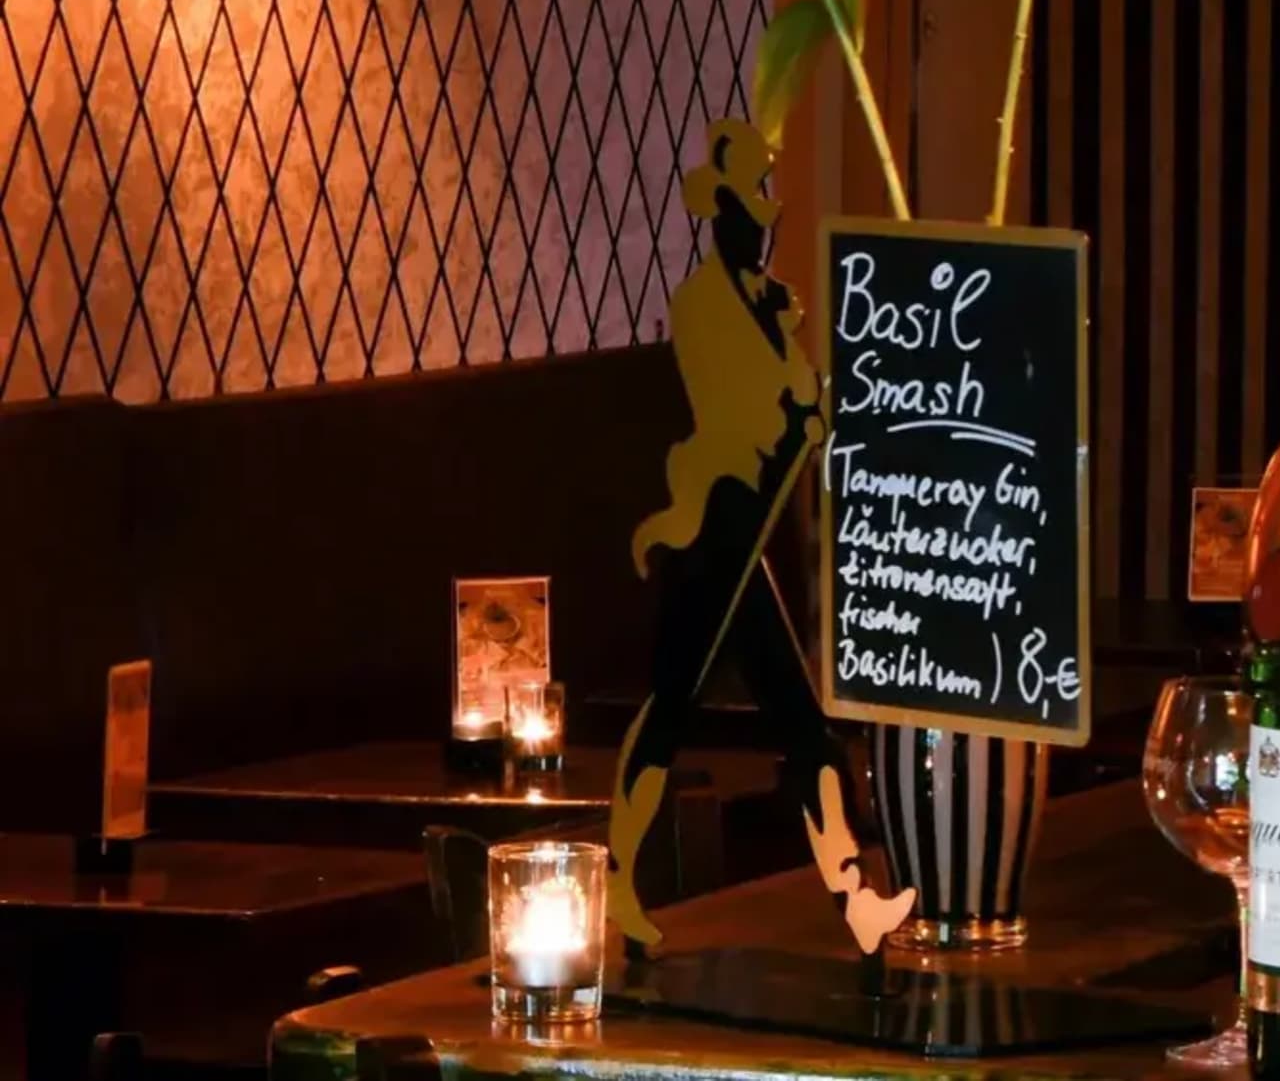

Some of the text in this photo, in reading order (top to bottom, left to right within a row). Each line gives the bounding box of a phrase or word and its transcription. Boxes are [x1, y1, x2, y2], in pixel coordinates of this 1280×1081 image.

[836, 252, 992, 351] Basil
[838, 351, 985, 418] Smash
[995, 462, 1047, 526] Gin,
